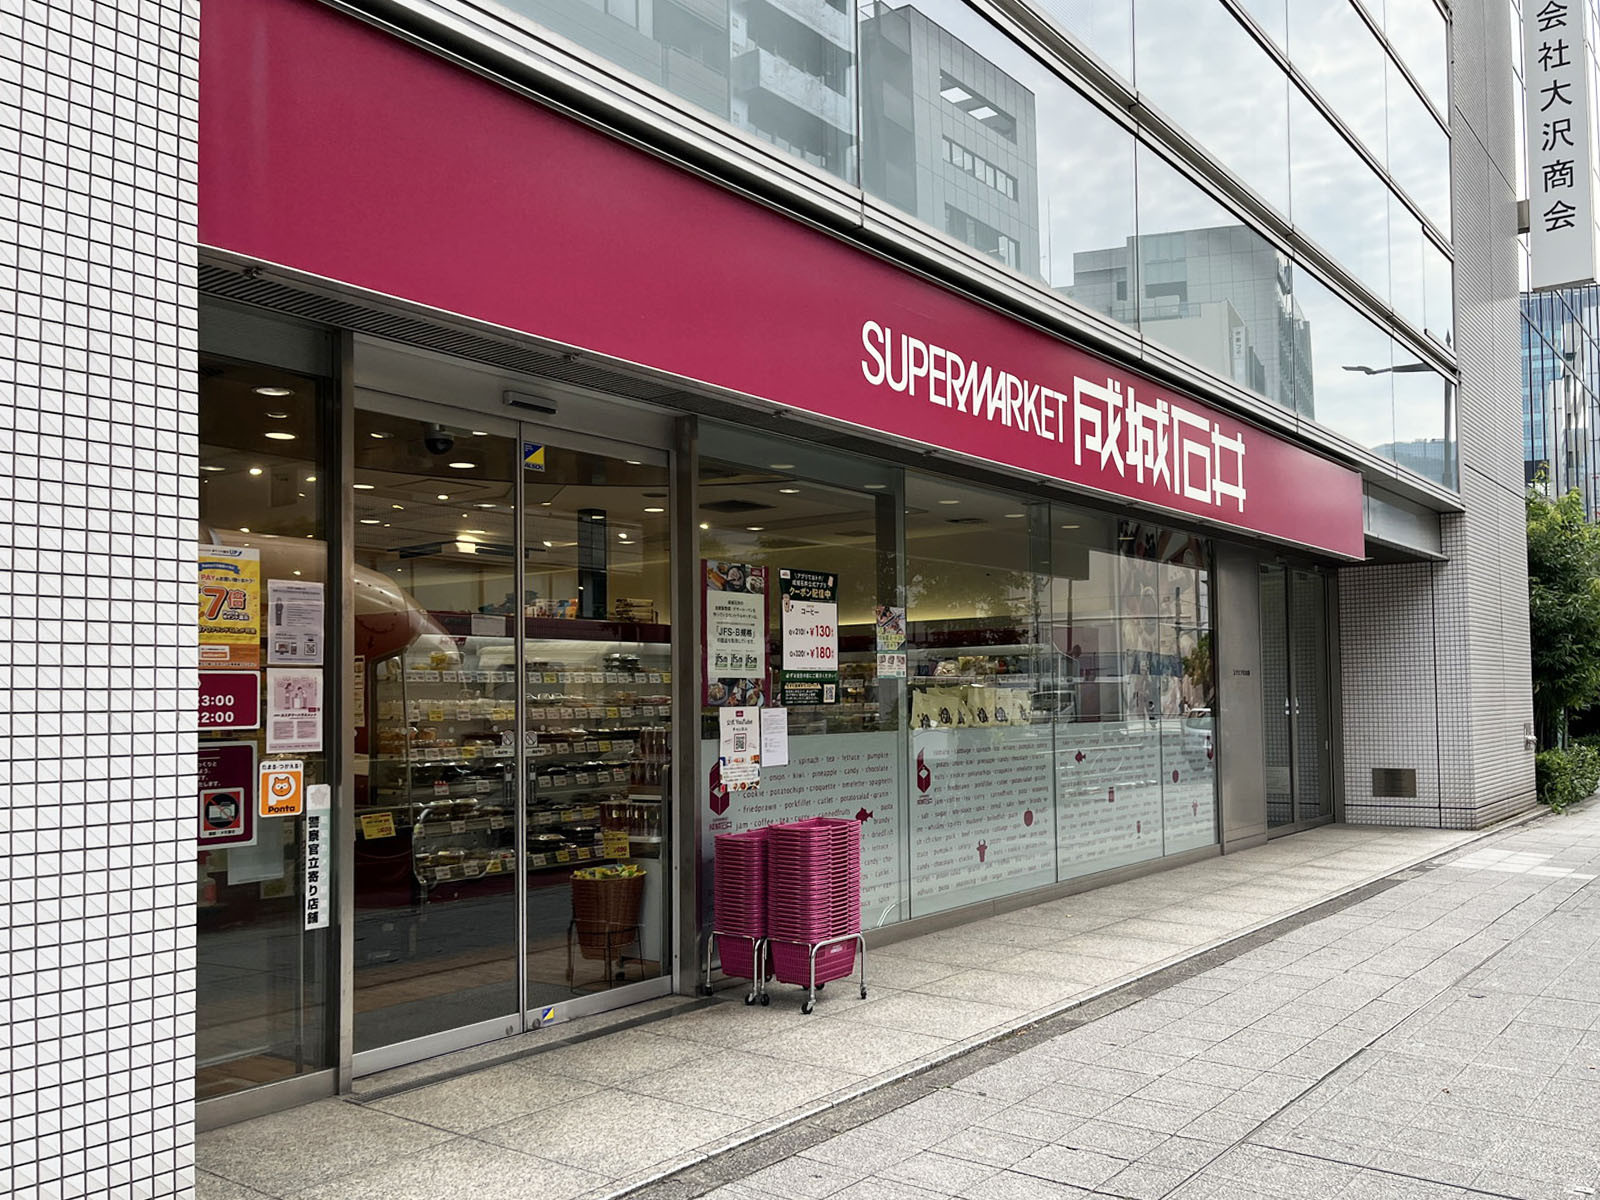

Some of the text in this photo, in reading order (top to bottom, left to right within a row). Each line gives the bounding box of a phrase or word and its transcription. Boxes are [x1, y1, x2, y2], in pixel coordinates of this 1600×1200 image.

[1536, 0, 1576, 232] 会社大沢商会
[861, 320, 1247, 513] SUPERMARKET 成城石井
[198, 694, 235, 707] 3:00
[198, 711, 235, 723] 2:00
[742, 789, 765, 798] cookie
[268, 804, 295, 813] Ponta
[735, 822, 749, 831] jam
[754, 818, 774, 827] coffee
[308, 815, 319, 925] 警察官立寄り店舗
